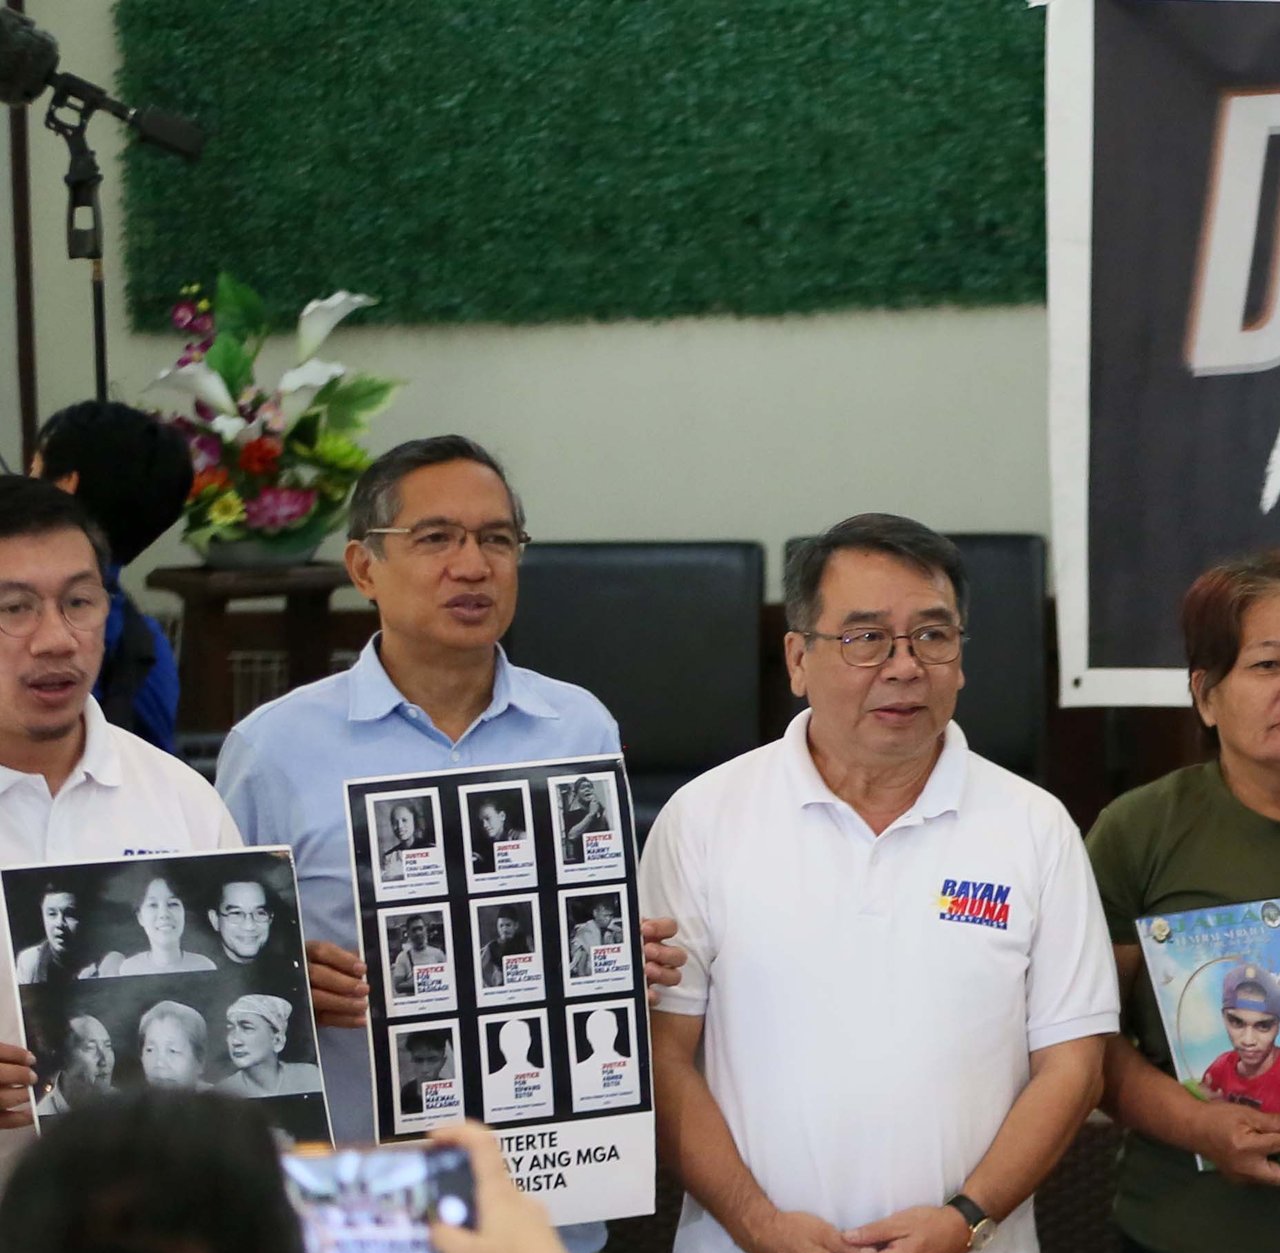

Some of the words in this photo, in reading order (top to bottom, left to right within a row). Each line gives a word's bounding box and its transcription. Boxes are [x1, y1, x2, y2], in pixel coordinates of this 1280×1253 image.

[941, 879, 1011, 904] BAYAN
[948, 896, 1009, 923] MUNA
[500, 1131, 558, 1153] TERTE
[529, 1151, 571, 1171] ANG
[577, 1145, 619, 1166] MGA
[515, 1173, 567, 1192] BISTA
